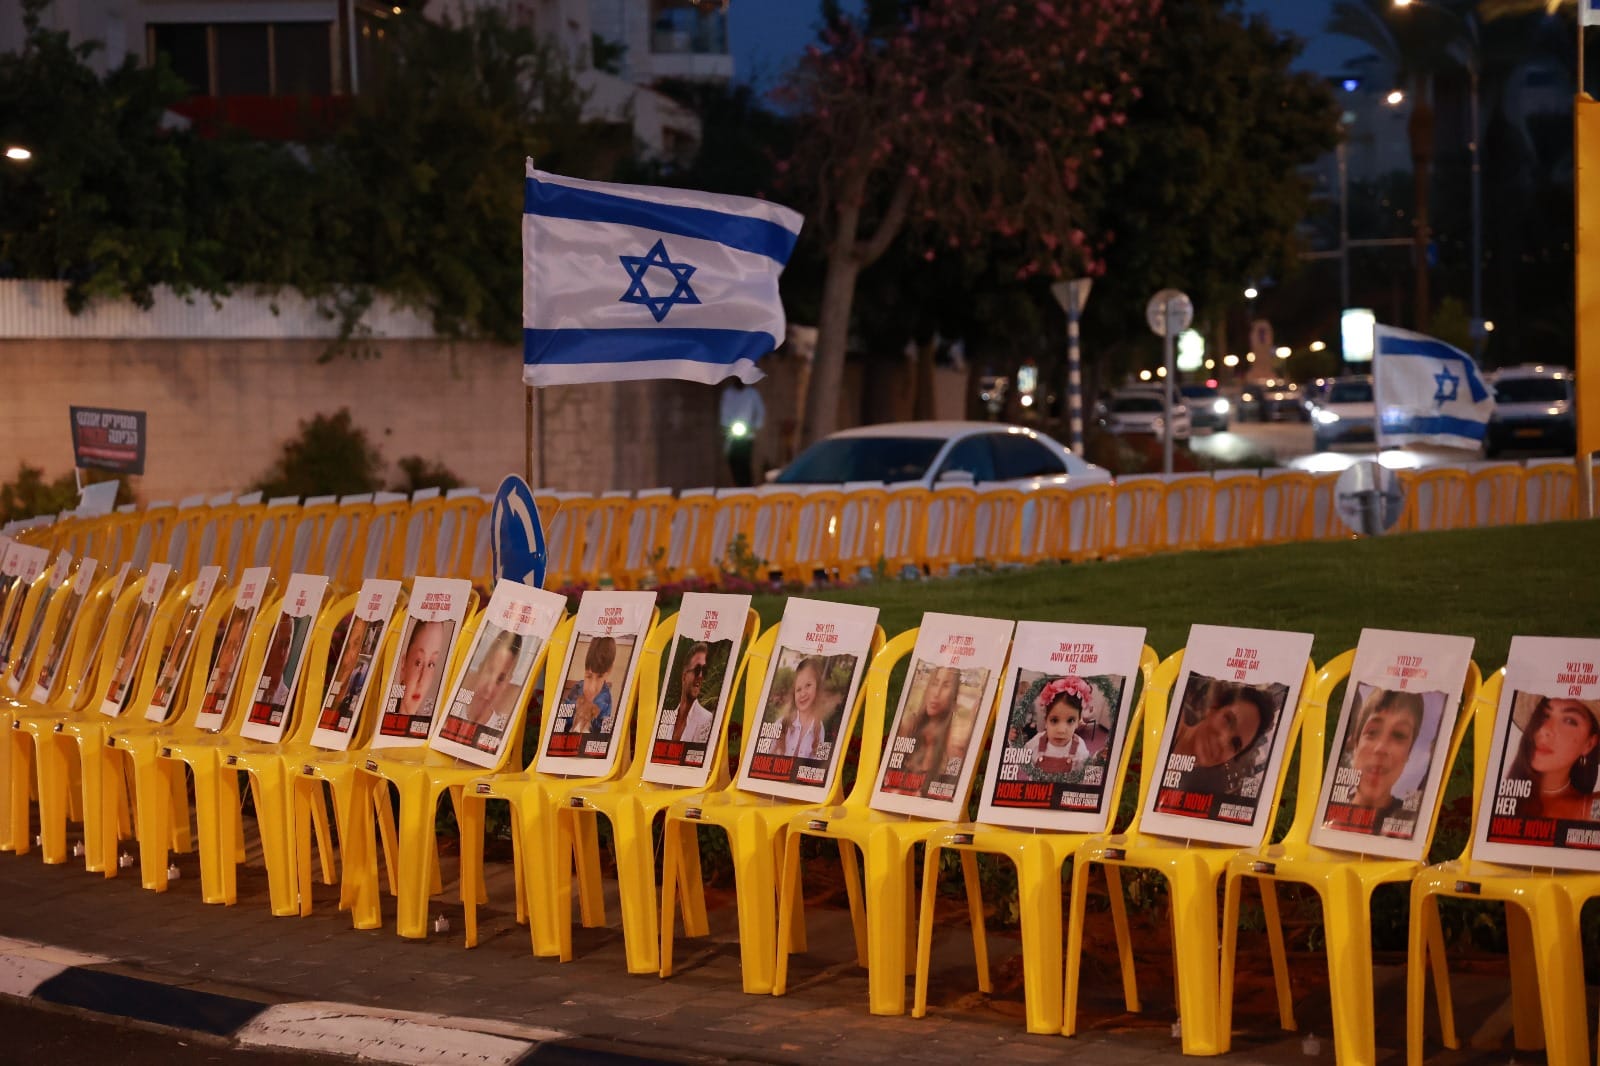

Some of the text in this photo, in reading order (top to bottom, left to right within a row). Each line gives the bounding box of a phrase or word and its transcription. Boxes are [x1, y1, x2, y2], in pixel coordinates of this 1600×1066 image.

[1050, 652, 1099, 664] AVIV KATZ ASHER
[1226, 657, 1261, 670] CARMEL GAT
[1556, 673, 1599, 685] SHANI GABAY
[1003, 747, 1033, 765] BRING
[1167, 753, 1196, 772] BRING
[1000, 764, 1019, 780] HER
[1163, 770, 1182, 788] HER
[1335, 767, 1362, 786] BRING
[996, 783, 1024, 799] HOME
[1024, 783, 1055, 800] NOW!
[1498, 778, 1532, 798] BRING
[1495, 797, 1517, 816] HER
[1492, 817, 1522, 836] HOME
[1524, 819, 1557, 840] NOW!
